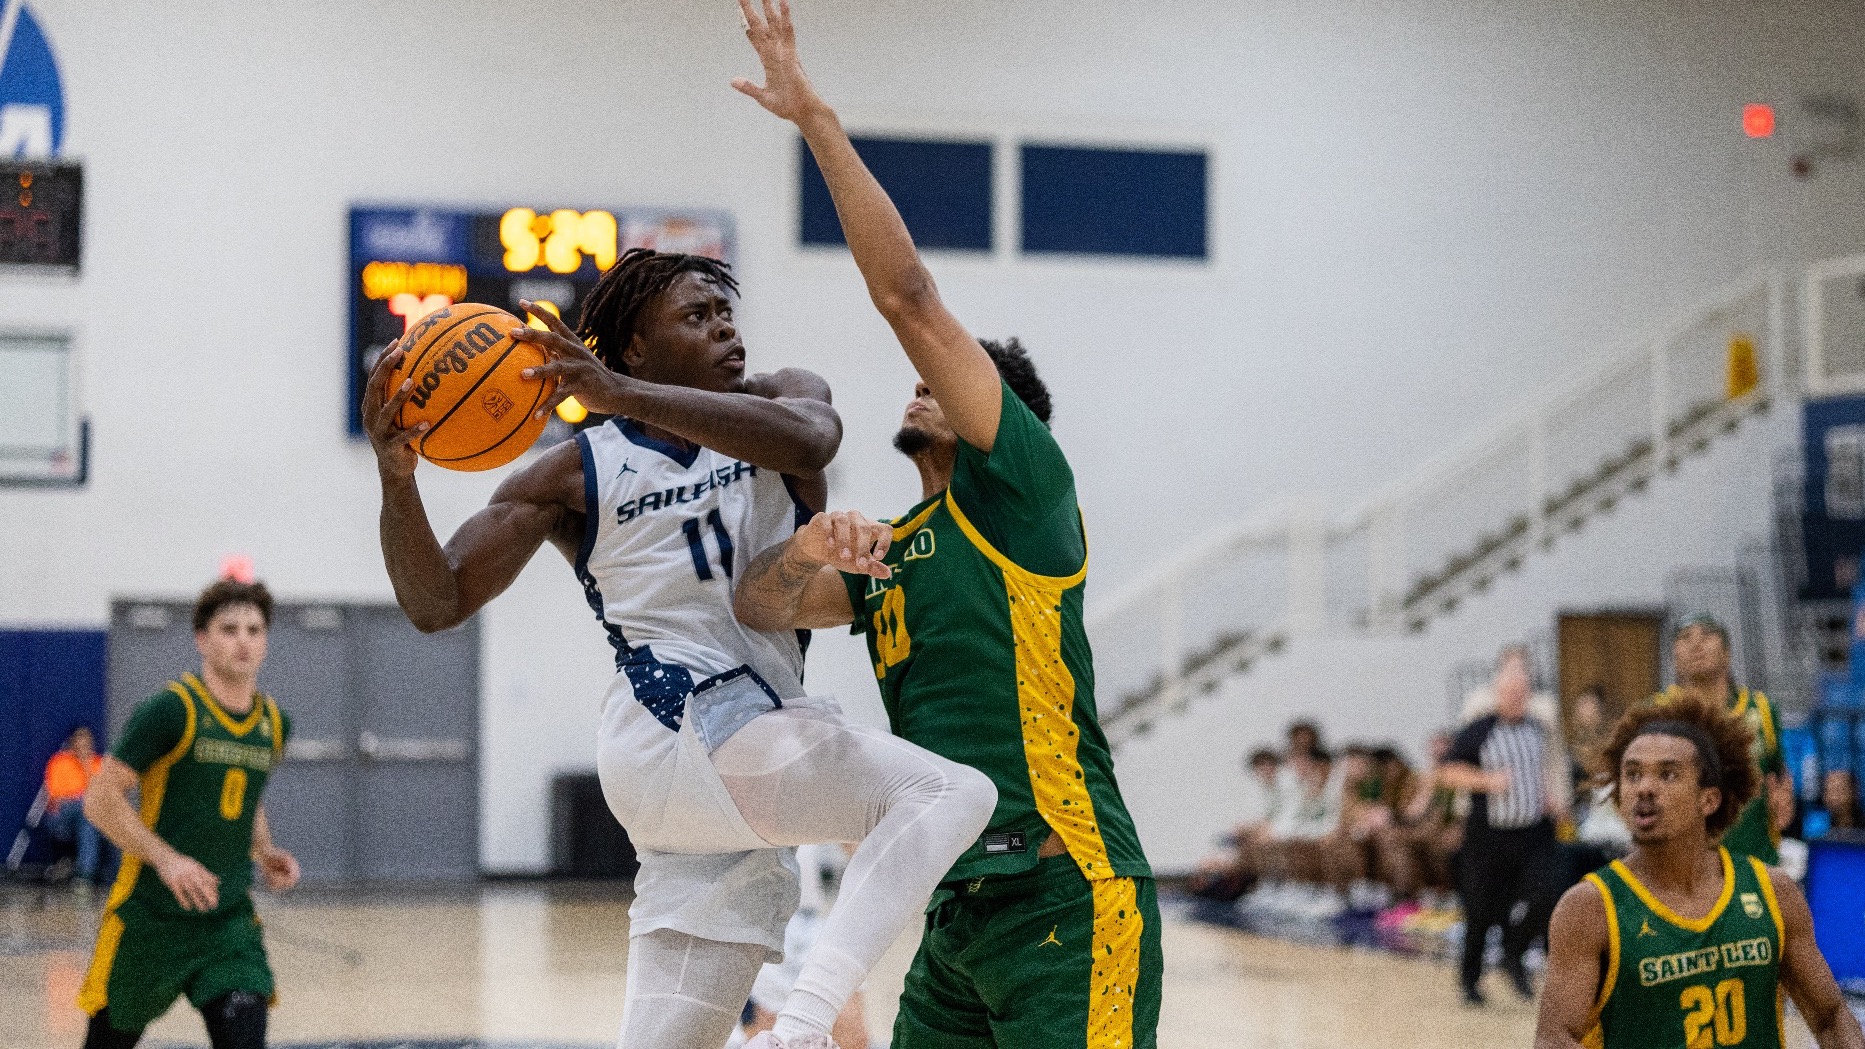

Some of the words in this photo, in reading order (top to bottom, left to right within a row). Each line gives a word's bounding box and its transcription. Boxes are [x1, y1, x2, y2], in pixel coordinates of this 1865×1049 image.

[410, 322, 505, 409] Wilson
[682, 508, 733, 581] 11
[220, 767, 247, 820] 0
[1011, 837, 1022, 847] XL
[1640, 947, 1718, 985] SAINT
[1723, 938, 1771, 967] LEO
[1680, 978, 1747, 1049] 20
